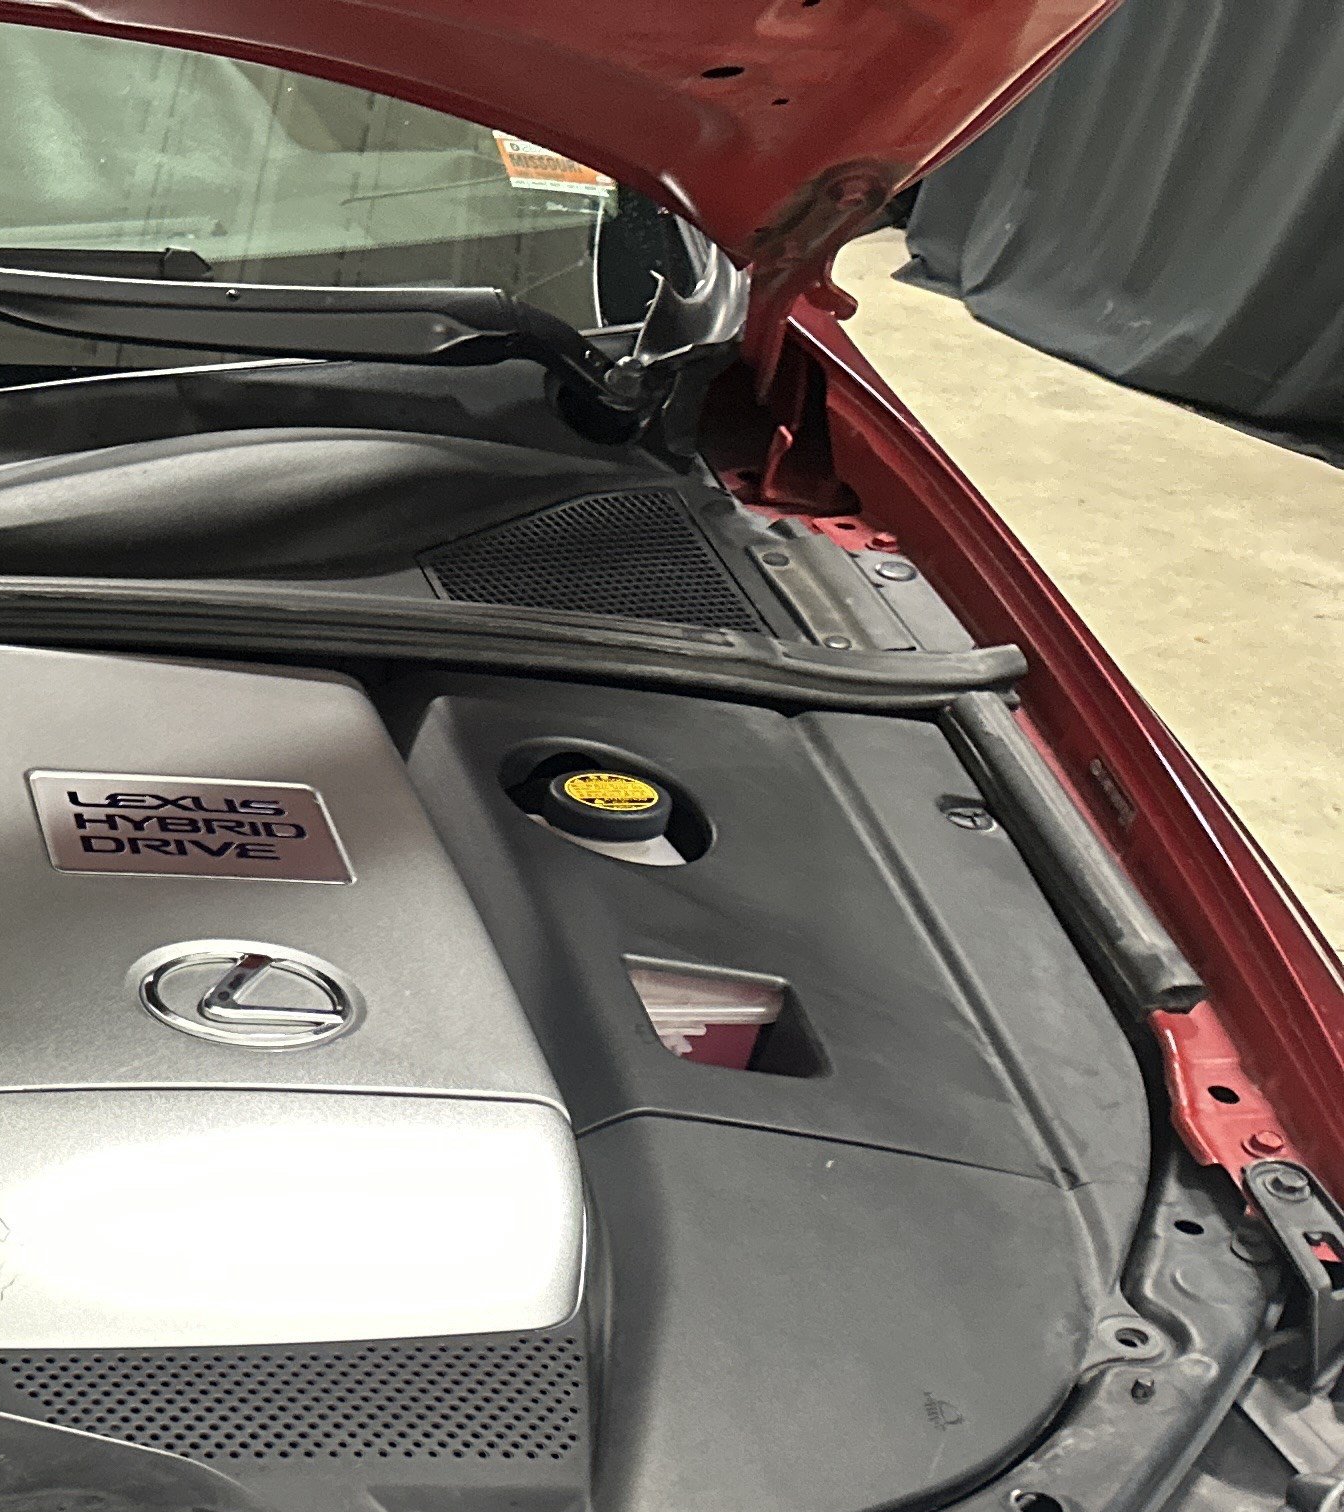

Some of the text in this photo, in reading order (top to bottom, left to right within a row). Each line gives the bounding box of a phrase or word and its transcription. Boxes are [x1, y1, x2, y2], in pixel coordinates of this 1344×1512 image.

[67, 790, 287, 816] LEXUS
[74, 812, 307, 840] HYBRID
[81, 835, 281, 861] DRIVE
